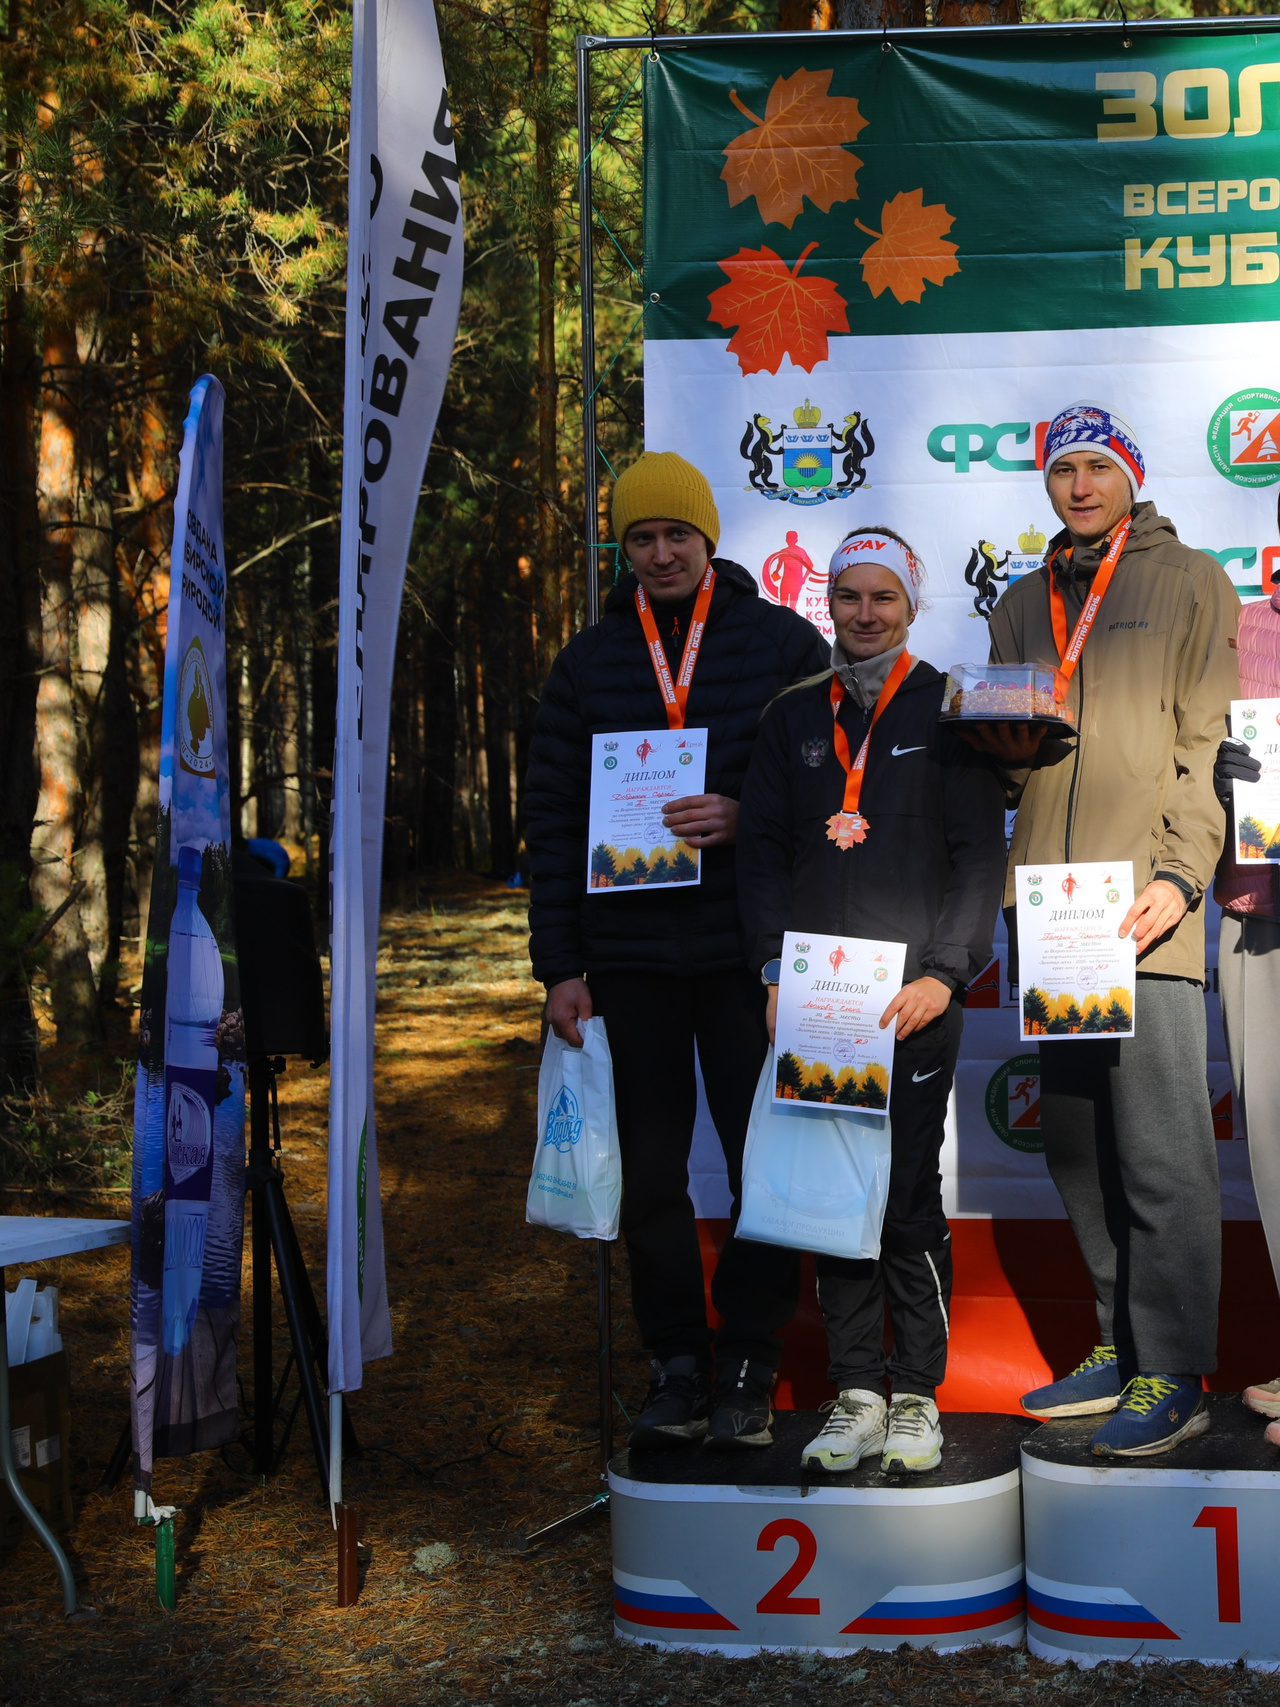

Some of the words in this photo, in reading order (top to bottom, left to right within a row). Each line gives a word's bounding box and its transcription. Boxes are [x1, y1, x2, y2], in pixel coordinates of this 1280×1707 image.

[1212, 402, 1235, 441] ФЕДЕРАЦИЯ
[1212, 445, 1231, 474] ОБЛАСТИ
[187, 508, 219, 566] ОЗДАНА
[1105, 530, 1126, 563] ТЮМЕНЬ
[184, 541, 225, 604] БИРСКОЙ
[181, 573, 221, 633] РИРОДОЙ
[806, 597, 830, 608] КУБ
[1069, 623, 1089, 663] ЗОЛОТАЯ
[1086, 595, 1101, 622] ОСЕНЬ
[1108, 621, 1136, 632] PATRIOT
[654, 640, 666, 666] ОСЕНЬ
[682, 650, 698, 687] ЗОЛОТАЯ
[691, 622, 704, 649] ОСЕНЬ
[662, 668, 677, 703] ЗОЛОТАЯ
[621, 769, 676, 784] ДИПЛОМ
[626, 784, 672, 793] НАГРАЖДАЕТСЯ
[1049, 908, 1105, 922] ДИПЛОМ
[811, 980, 870, 995] ДИПЛОМ
[815, 996, 864, 1006] НАГРАЖДАЕТСЯ
[754, 1518, 821, 1616] 2
[1191, 1506, 1242, 1625] 1
